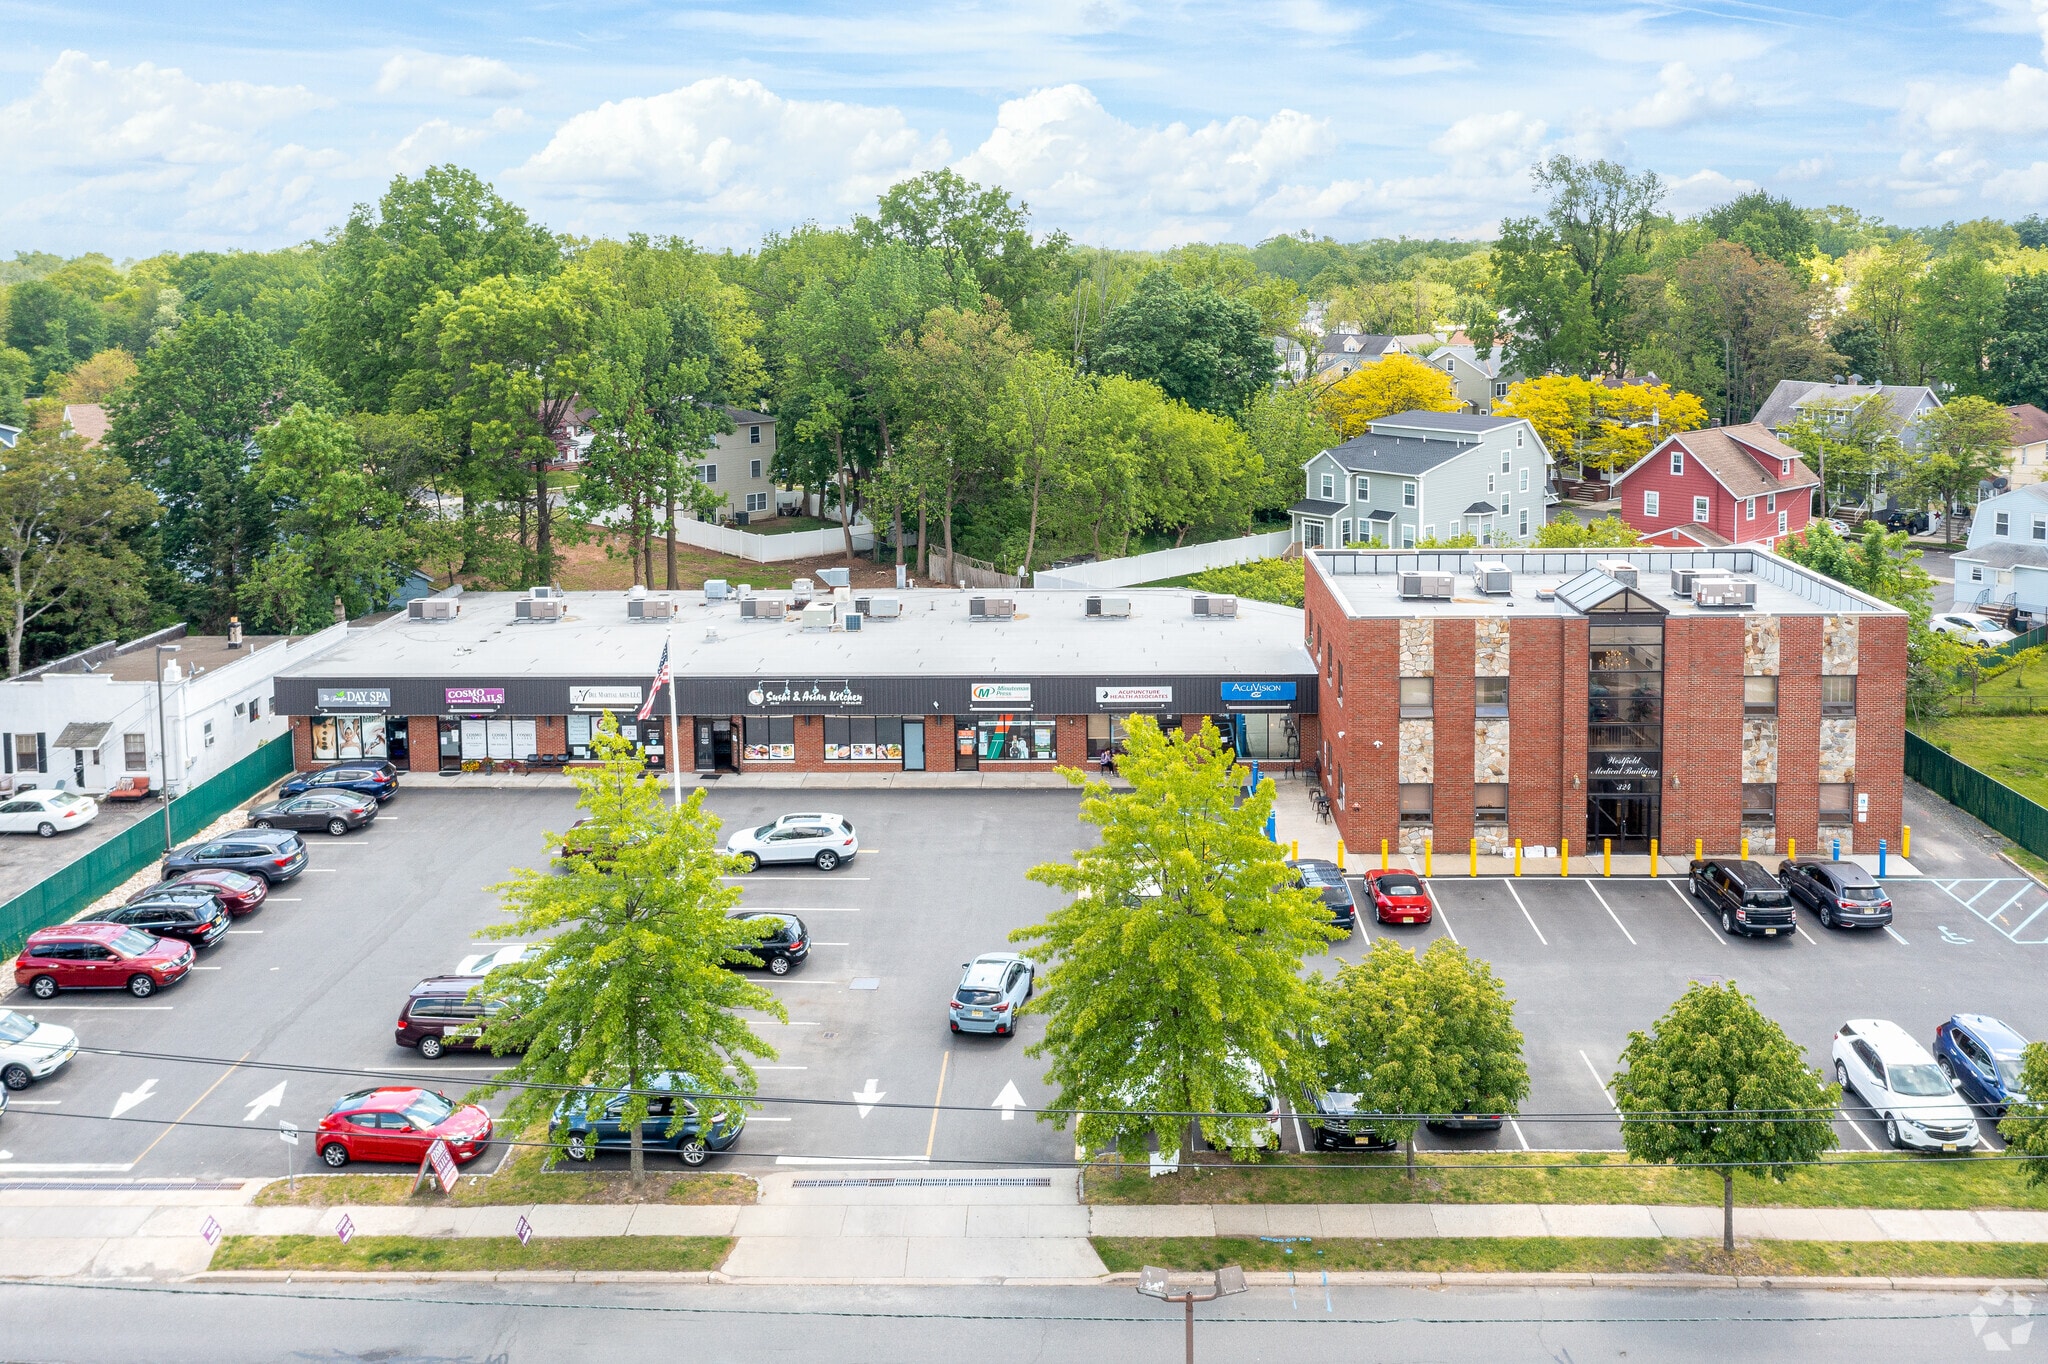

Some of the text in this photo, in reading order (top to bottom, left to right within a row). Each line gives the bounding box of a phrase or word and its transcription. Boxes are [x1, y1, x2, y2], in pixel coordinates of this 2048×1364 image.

[347, 691, 368, 702] DAY
[369, 691, 388, 702] SPA
[448, 689, 485, 699] COSMO
[472, 694, 503, 704] NAILS
[766, 690, 863, 702] Sushi & Asian Kitchen
[1607, 756, 1642, 767] Westfield
[1590, 766, 1658, 778] Medical Building
[1616, 783, 1632, 791] 324
